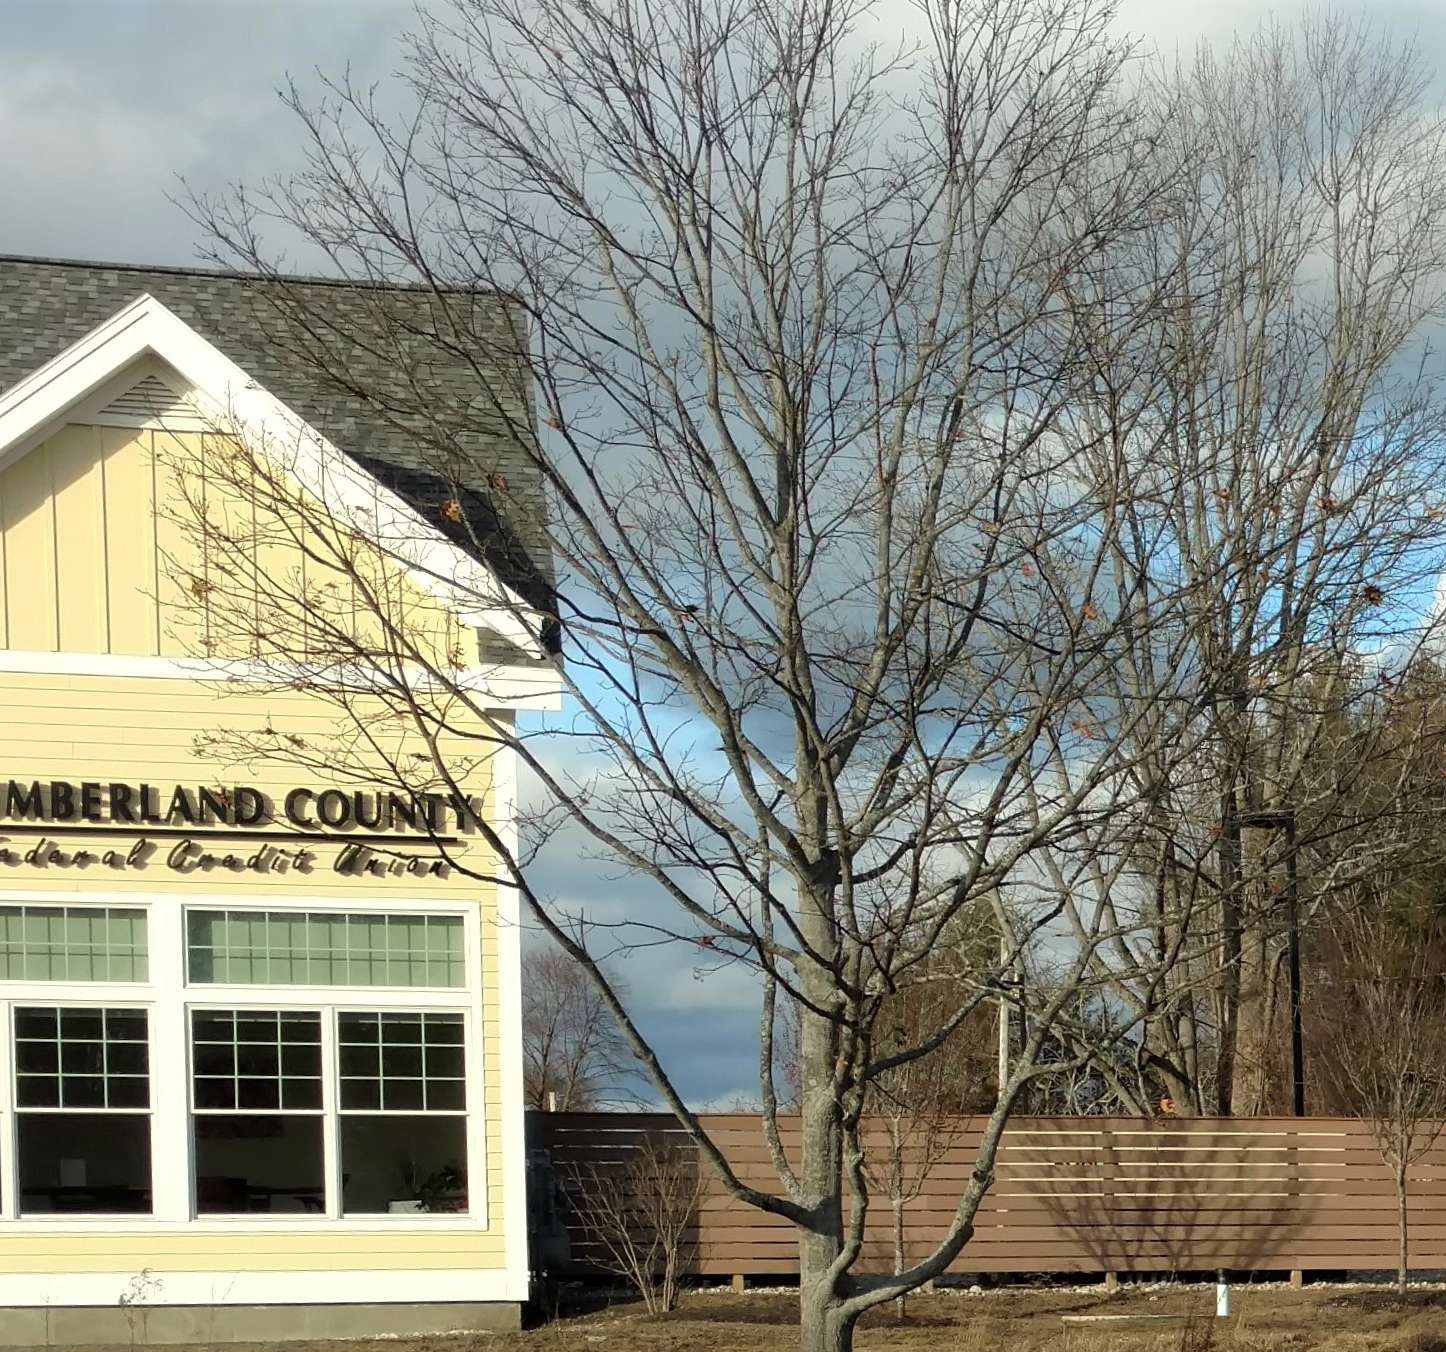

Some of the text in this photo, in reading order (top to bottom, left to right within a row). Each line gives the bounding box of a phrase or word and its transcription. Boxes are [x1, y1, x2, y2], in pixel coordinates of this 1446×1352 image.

[6, 779, 473, 831] MBERLAND COUNTY
[166, 838, 307, 870] Credit
[333, 843, 443, 877] Union
